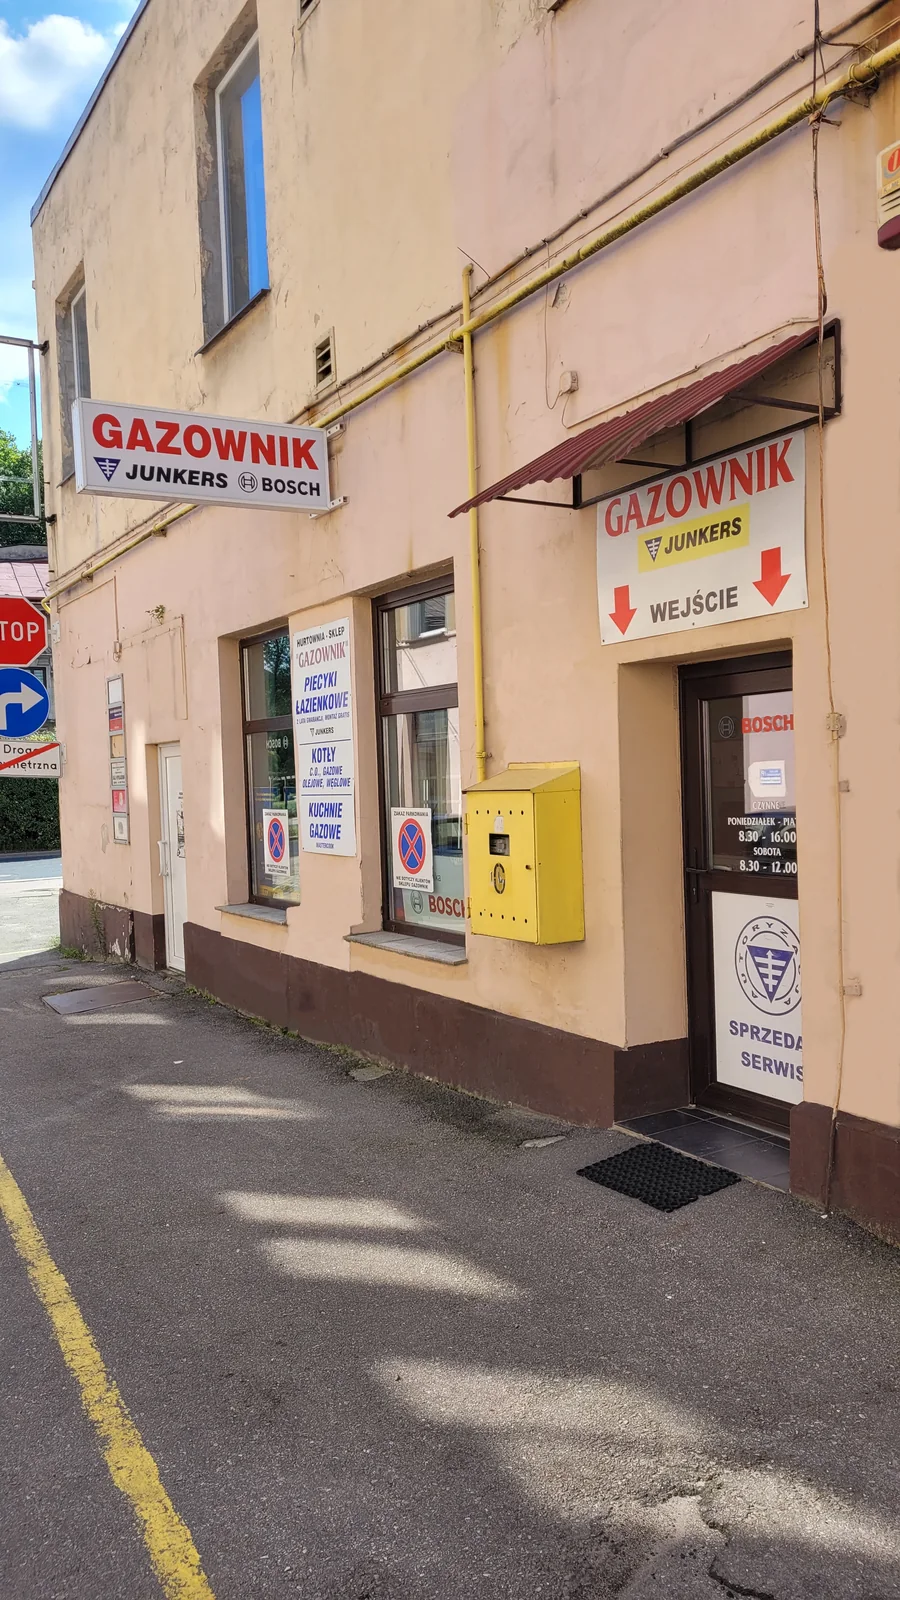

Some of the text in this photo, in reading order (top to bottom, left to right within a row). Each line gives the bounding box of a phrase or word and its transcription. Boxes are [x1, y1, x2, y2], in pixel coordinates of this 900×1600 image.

[92, 413, 319, 471] GAZOWNIK
[125, 464, 228, 489] JUNKERS
[261, 477, 321, 497] BOSCH
[604, 437, 795, 537] GAZOWNIK
[664, 516, 742, 554] JUNKERS
[650, 585, 739, 623] WEJŚCIE
[296, 631, 325, 648] HURTOWNIA
[328, 626, 345, 639] SKLEP
[303, 670, 338, 692] PIECYKI
[295, 691, 349, 715] ŁAZIENKOWE
[315, 726, 334, 736] JUNKERS
[742, 714, 795, 734] BOSCH
[3, 744, 41, 756] Drog
[311, 747, 337, 764] KOTŁY
[0, 761, 57, 771] nętrzna
[322, 765, 343, 776] GAZOWE
[326, 777, 351, 790] WĘGLOWE
[308, 802, 343, 818] KUCHNIE
[752, 801, 780, 810] CZYNNE
[727, 817, 776, 826] PONIEDZIAŁEK
[783, 817, 797, 828] PIĄ
[309, 823, 342, 840] GAZOWE
[738, 830, 759, 843] 8.30
[770, 830, 797, 843] 16.00
[753, 848, 782, 857] SOBOTA
[739, 860, 760, 872] 8.30
[771, 861, 797, 874] 12.00
[741, 1051, 804, 1082] SERWIS
